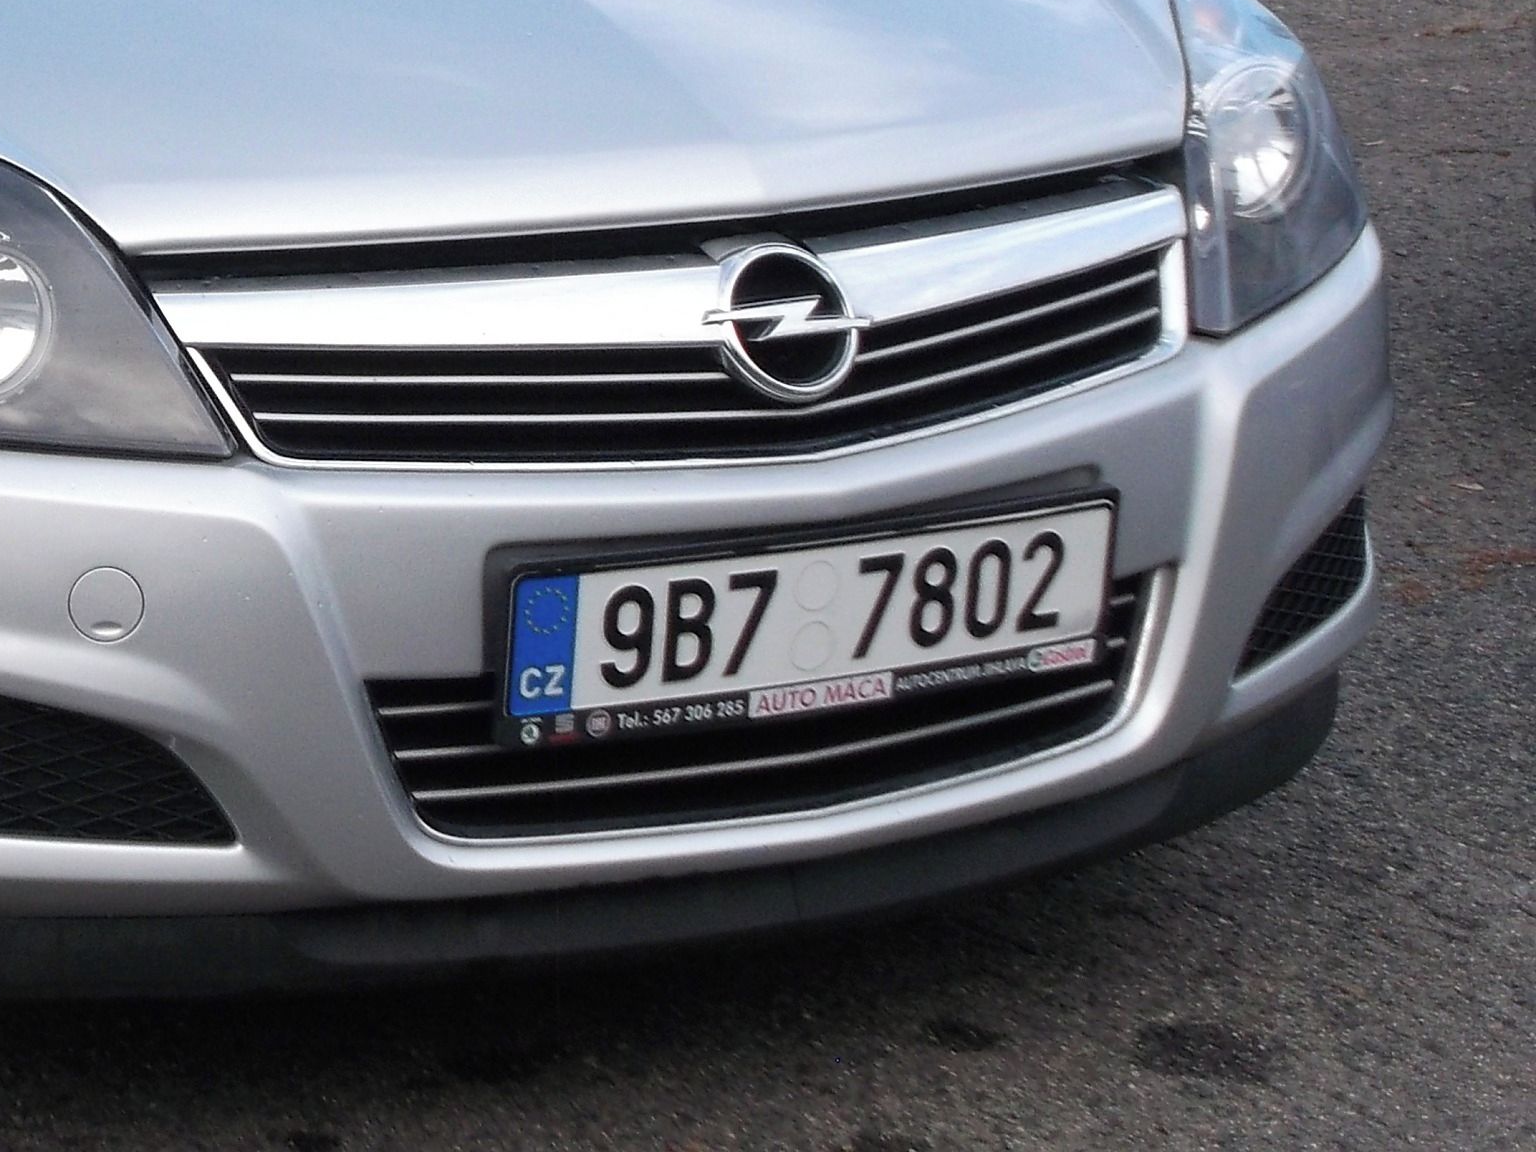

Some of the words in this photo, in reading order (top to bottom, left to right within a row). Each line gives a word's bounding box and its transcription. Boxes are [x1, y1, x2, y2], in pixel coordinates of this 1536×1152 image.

[600, 569, 779, 689] 9B7
[851, 530, 1065, 659] 7802
[519, 665, 565, 698] CZ
[652, 707, 681, 726] 567
[684, 703, 713, 722] 306
[756, 687, 817, 713] AUTO
